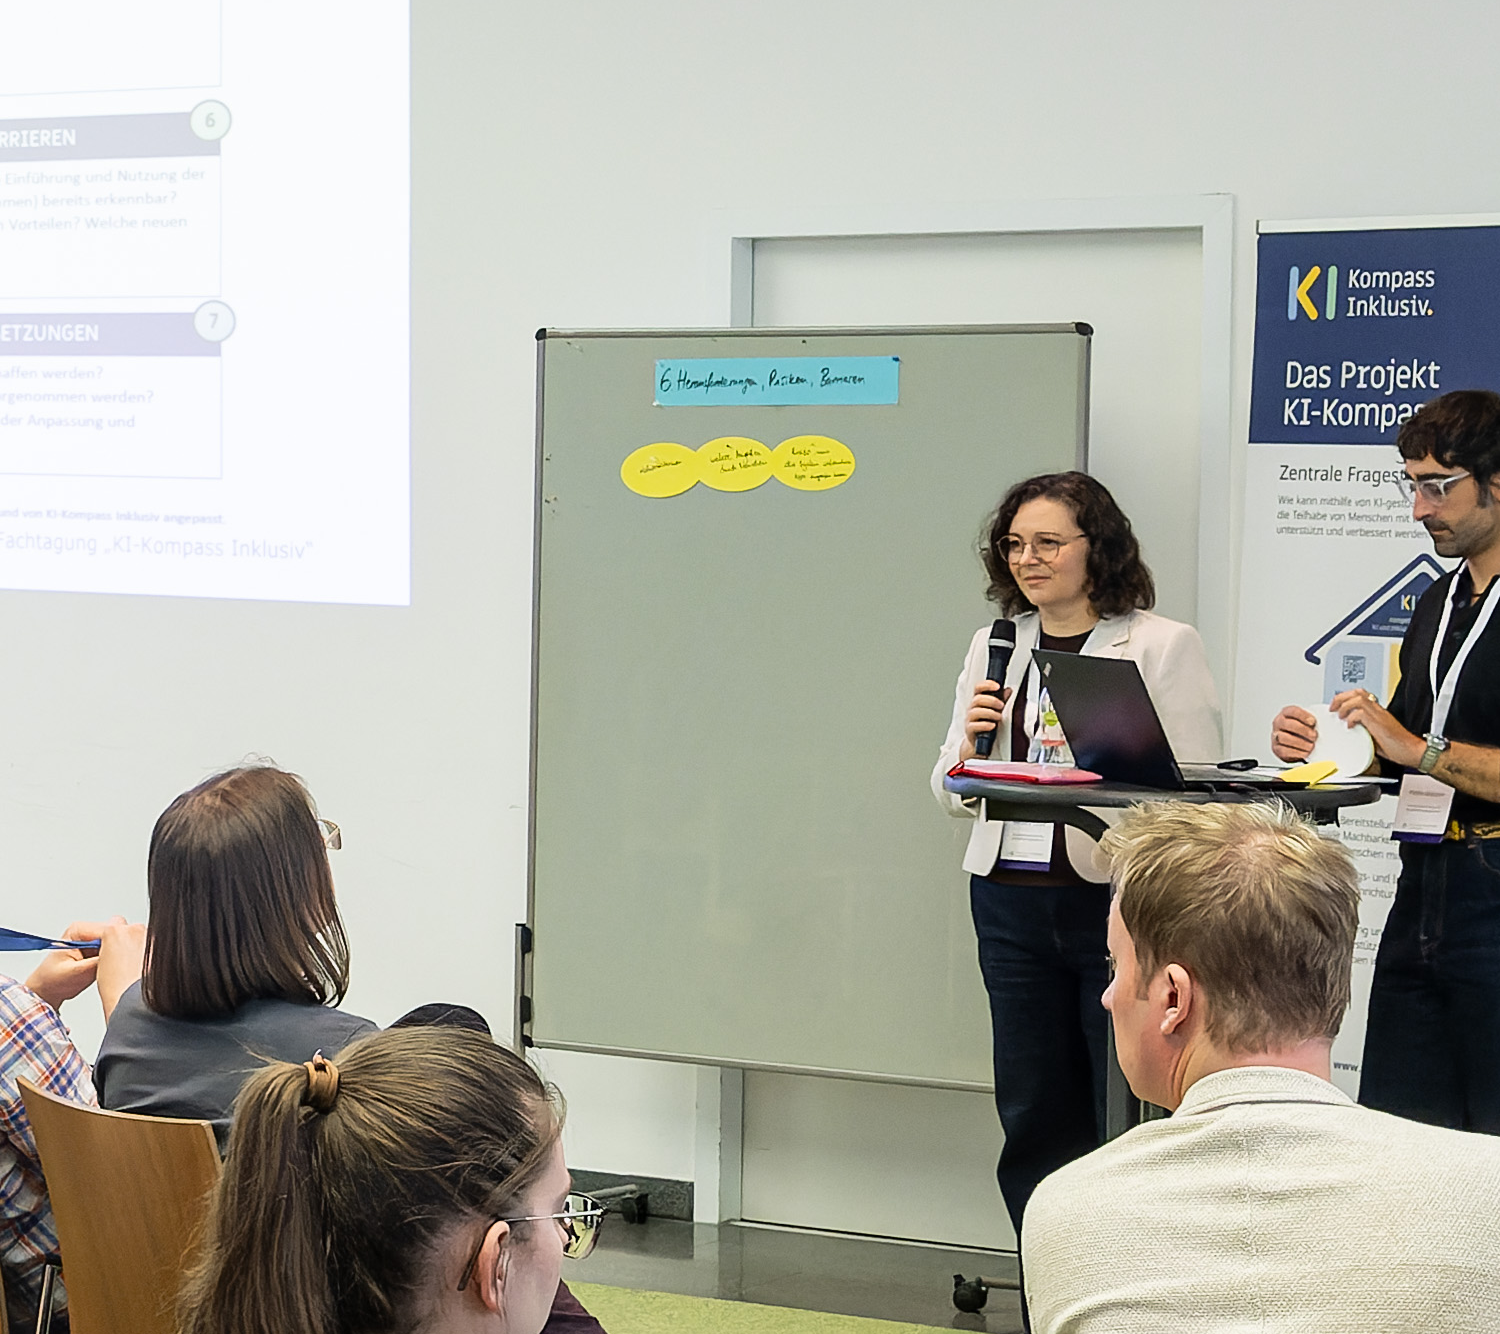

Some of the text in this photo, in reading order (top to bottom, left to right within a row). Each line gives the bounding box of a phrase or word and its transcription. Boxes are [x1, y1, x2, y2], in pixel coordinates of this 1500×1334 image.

[205, 112, 216, 128] 6
[1347, 267, 1436, 292] Kompass
[1287, 264, 1338, 321] KI
[1346, 295, 1435, 319] Inklusiv.
[209, 312, 219, 329] 7
[1285, 359, 1441, 394] Das Projekt
[1279, 464, 1342, 482] Zentrale
